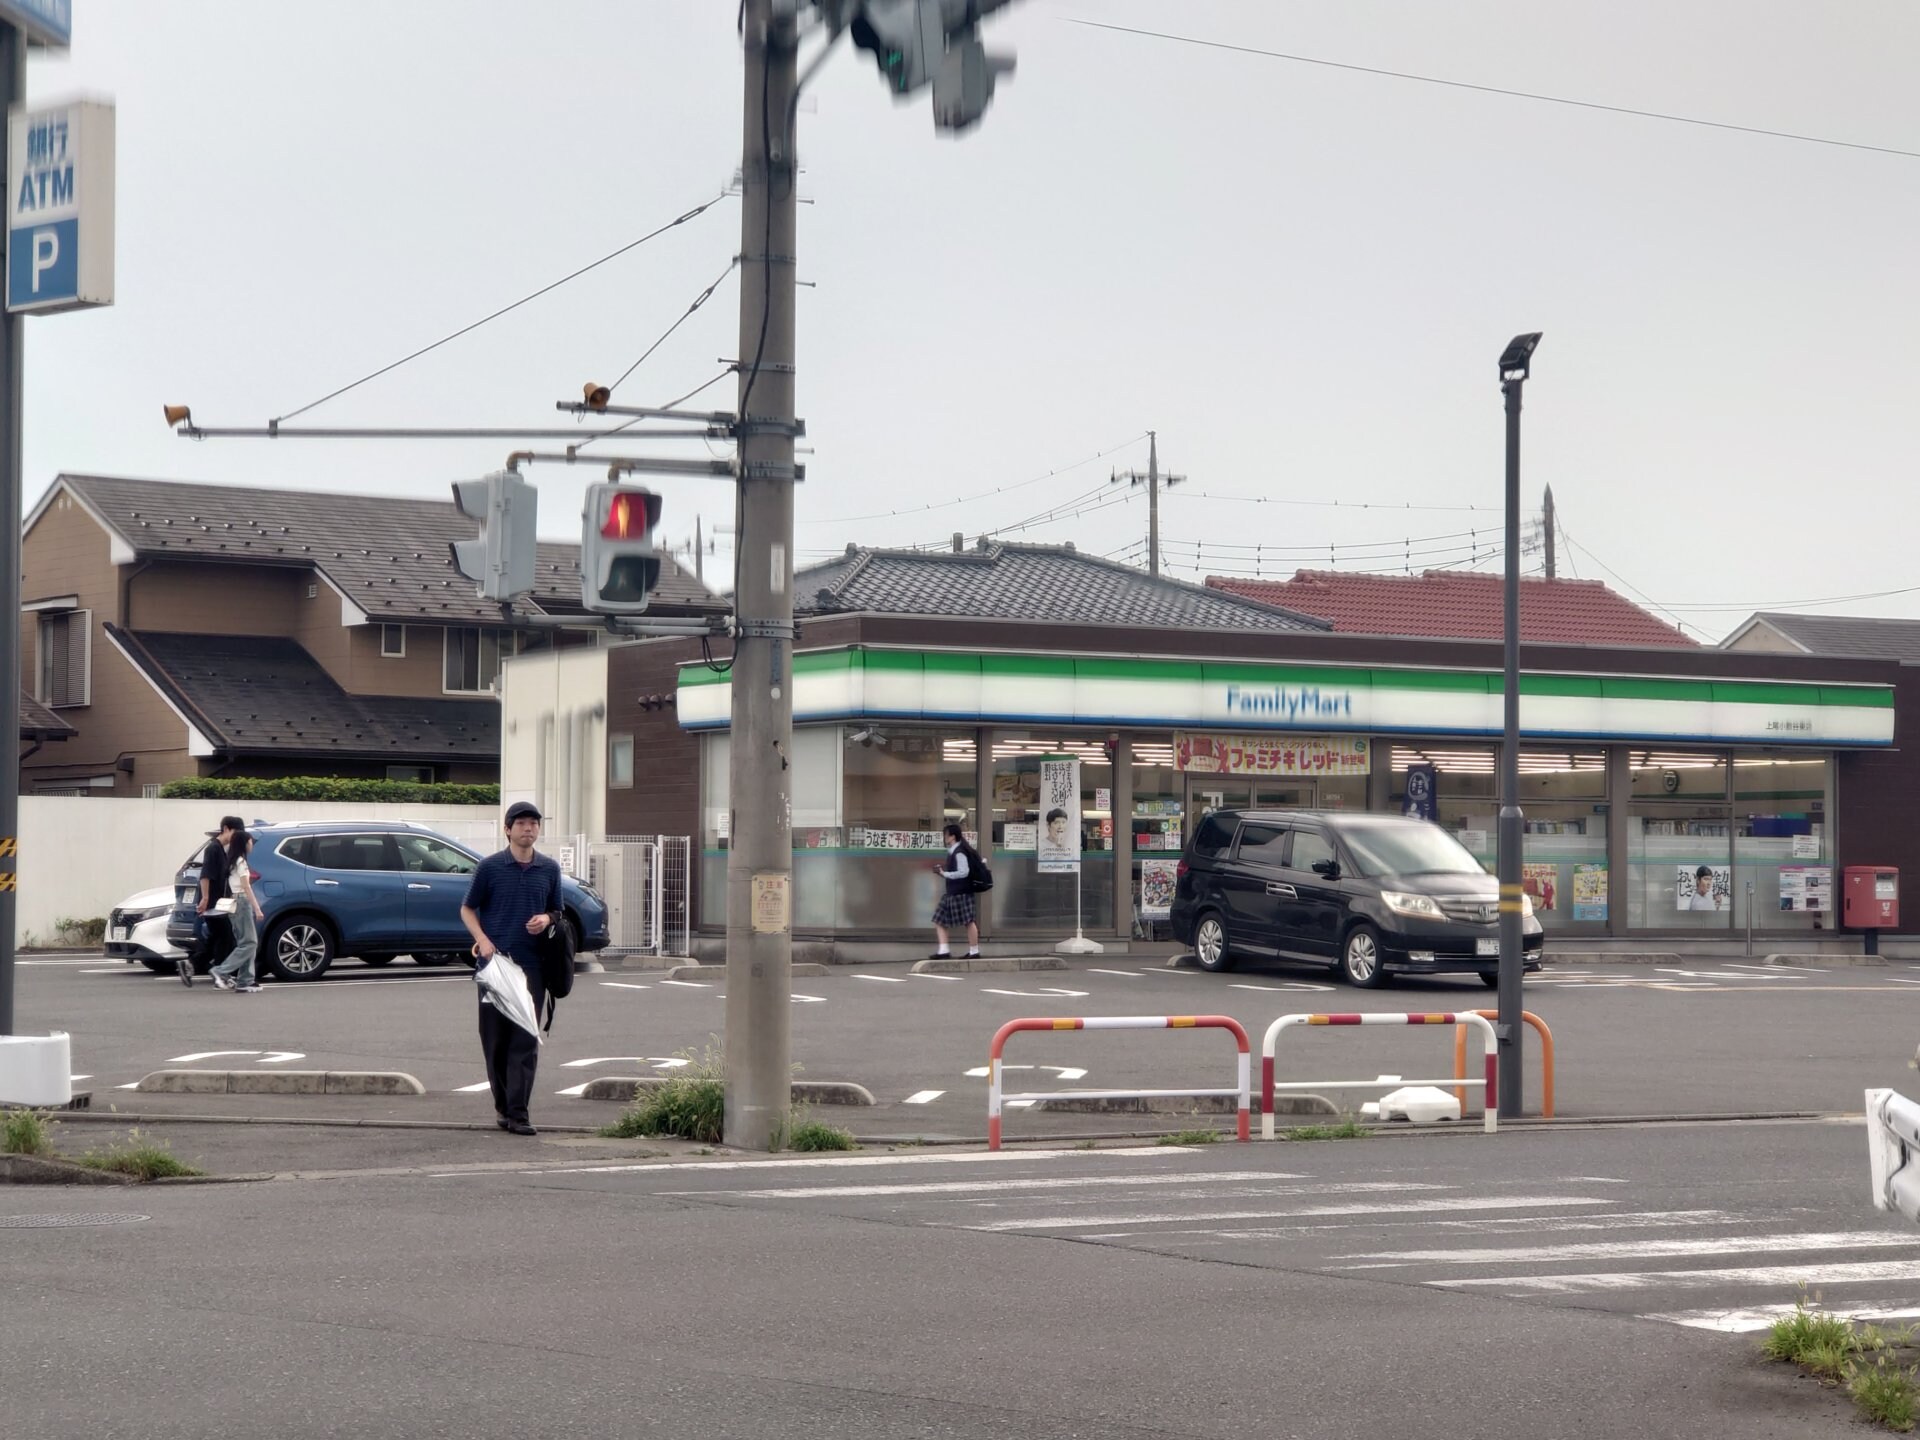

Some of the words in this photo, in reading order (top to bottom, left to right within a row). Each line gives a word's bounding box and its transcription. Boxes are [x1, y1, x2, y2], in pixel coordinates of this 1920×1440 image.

[17, 166, 74, 214] ATM
[32, 231, 59, 293] P
[1226, 687, 1352, 721] FamilyMart
[865, 832, 933, 849] うなぎご予約承り中
